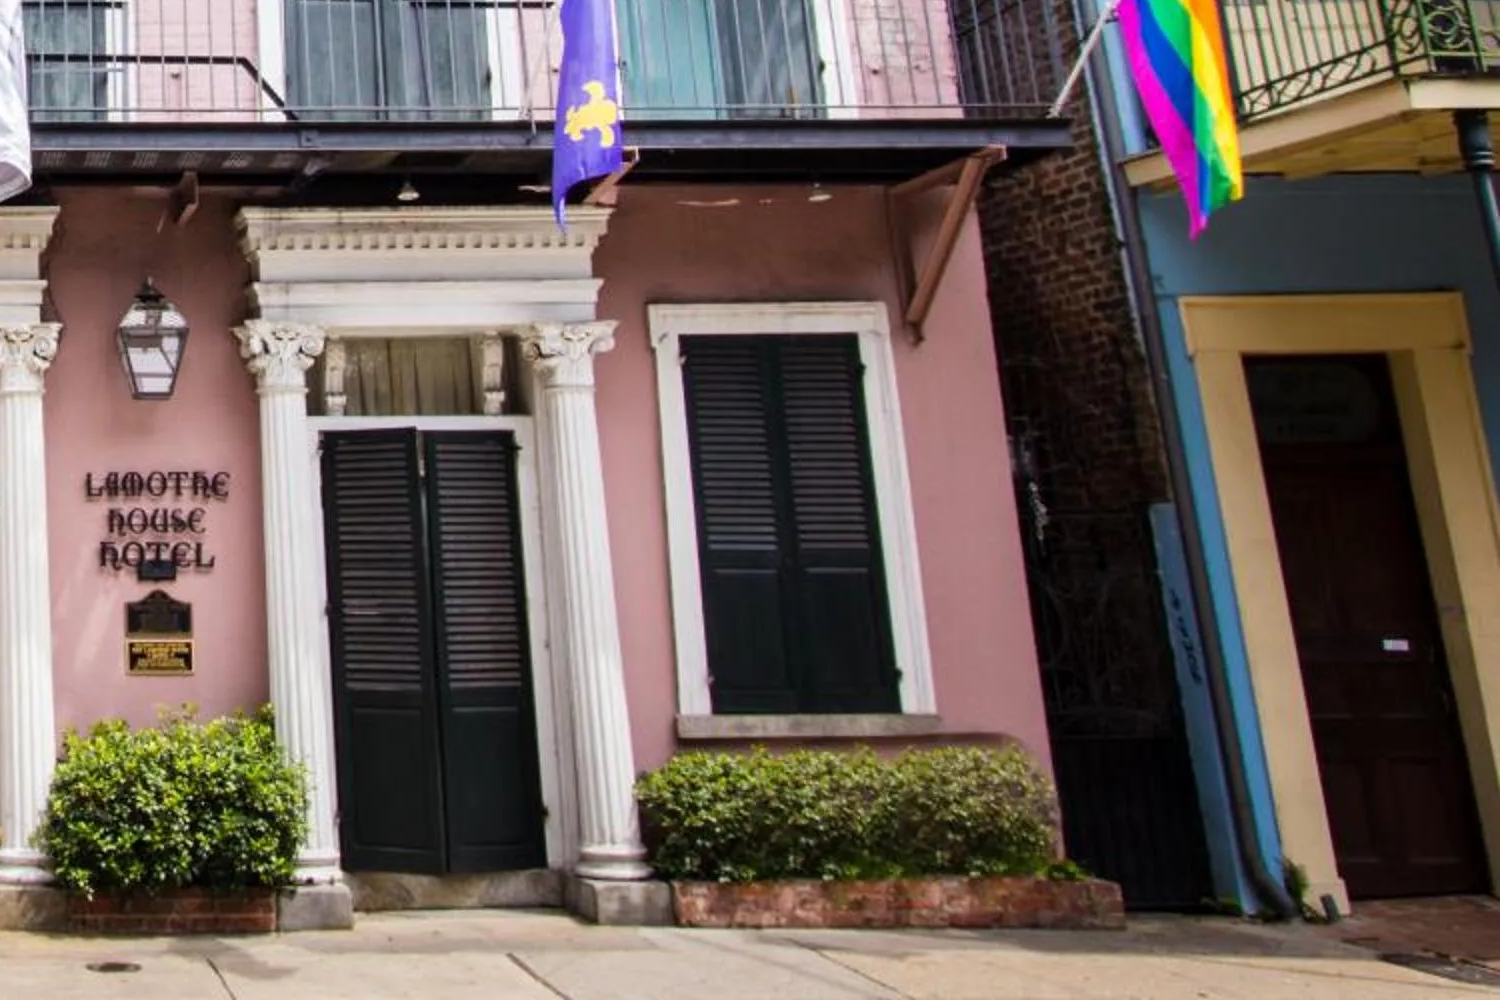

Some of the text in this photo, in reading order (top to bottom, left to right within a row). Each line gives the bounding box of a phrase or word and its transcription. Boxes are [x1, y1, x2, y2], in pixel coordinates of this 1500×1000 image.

[85, 471, 230, 497] LAMOTHE
[108, 508, 205, 536] HOUSE
[99, 541, 215, 570] HOTEL
